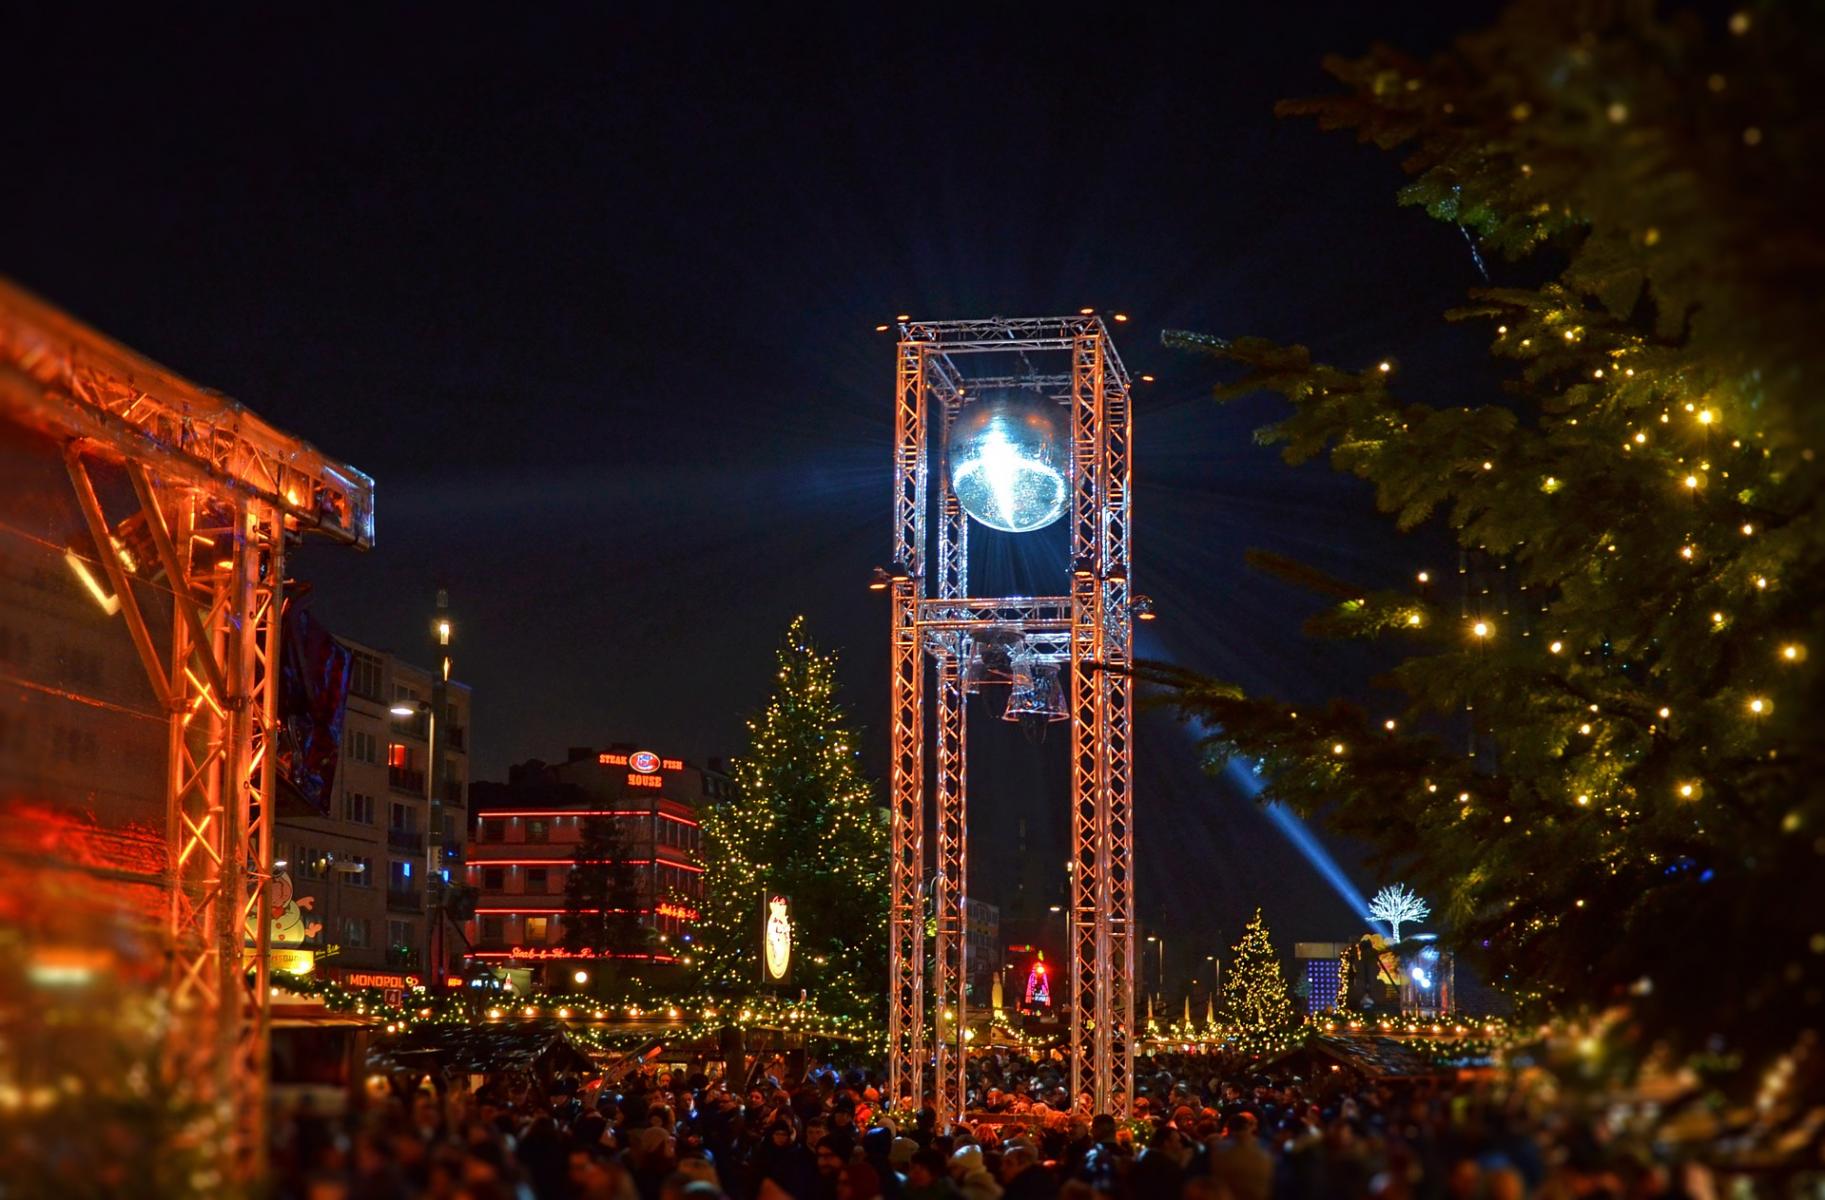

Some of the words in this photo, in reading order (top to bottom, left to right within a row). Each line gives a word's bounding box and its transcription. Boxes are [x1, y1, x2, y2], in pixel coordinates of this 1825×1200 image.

[599, 754, 627, 765] STEAK
[663, 760, 683, 770] FISH
[628, 774, 662, 788] HOUSE
[350, 974, 405, 988] MONOPOL
